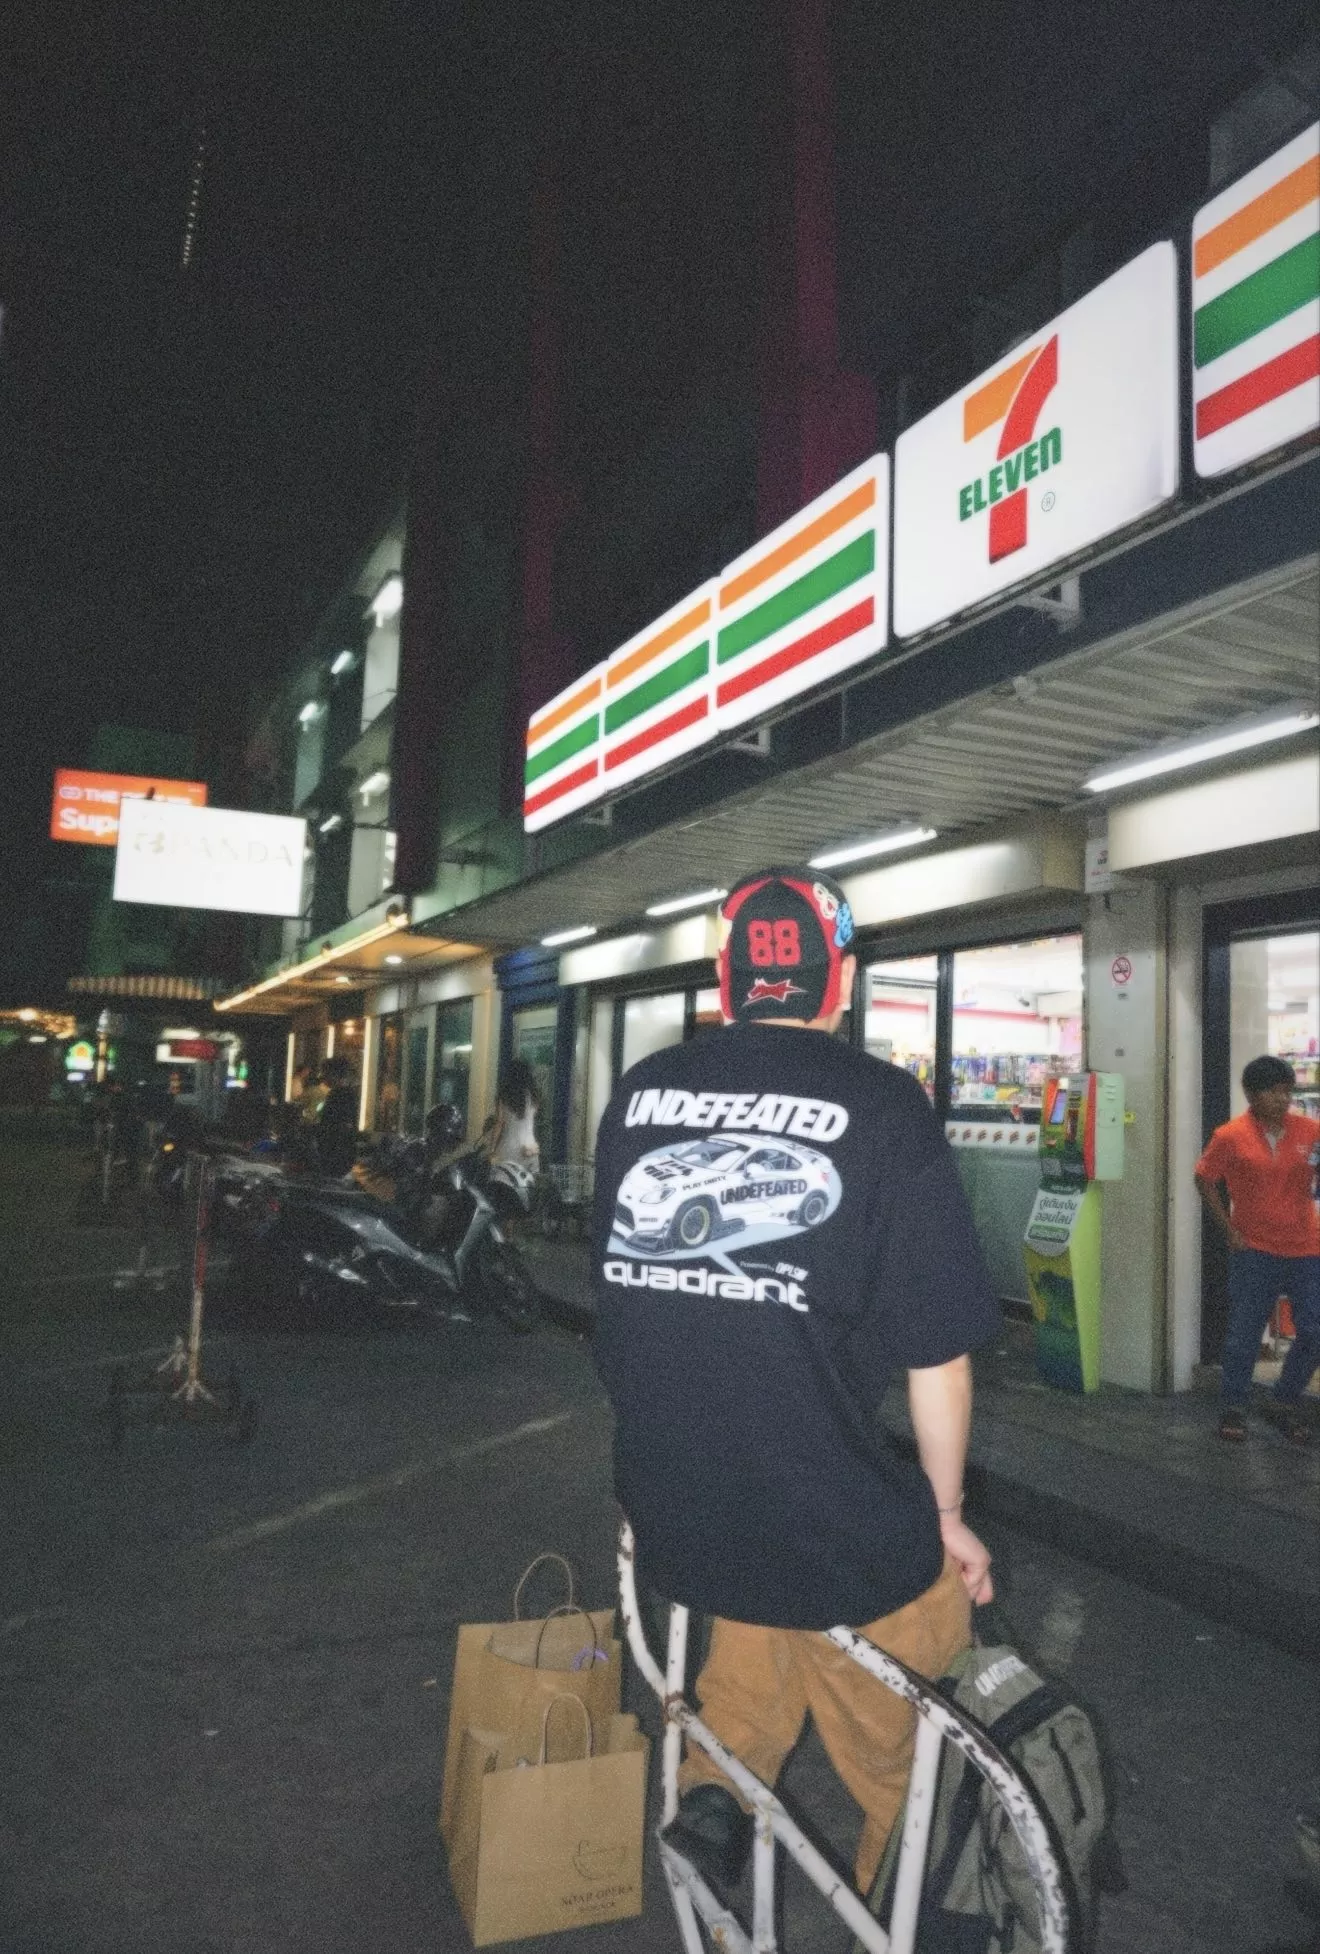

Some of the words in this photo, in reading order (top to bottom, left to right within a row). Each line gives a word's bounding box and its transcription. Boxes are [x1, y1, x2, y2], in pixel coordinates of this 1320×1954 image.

[963, 333, 1058, 564] 7
[58, 807, 119, 837] Sup
[748, 919, 802, 967] 88
[625, 1088, 848, 1142] UNDEFEATED
[720, 1179, 808, 1205] UNDEFEATED
[603, 1261, 809, 1312] quadrant
